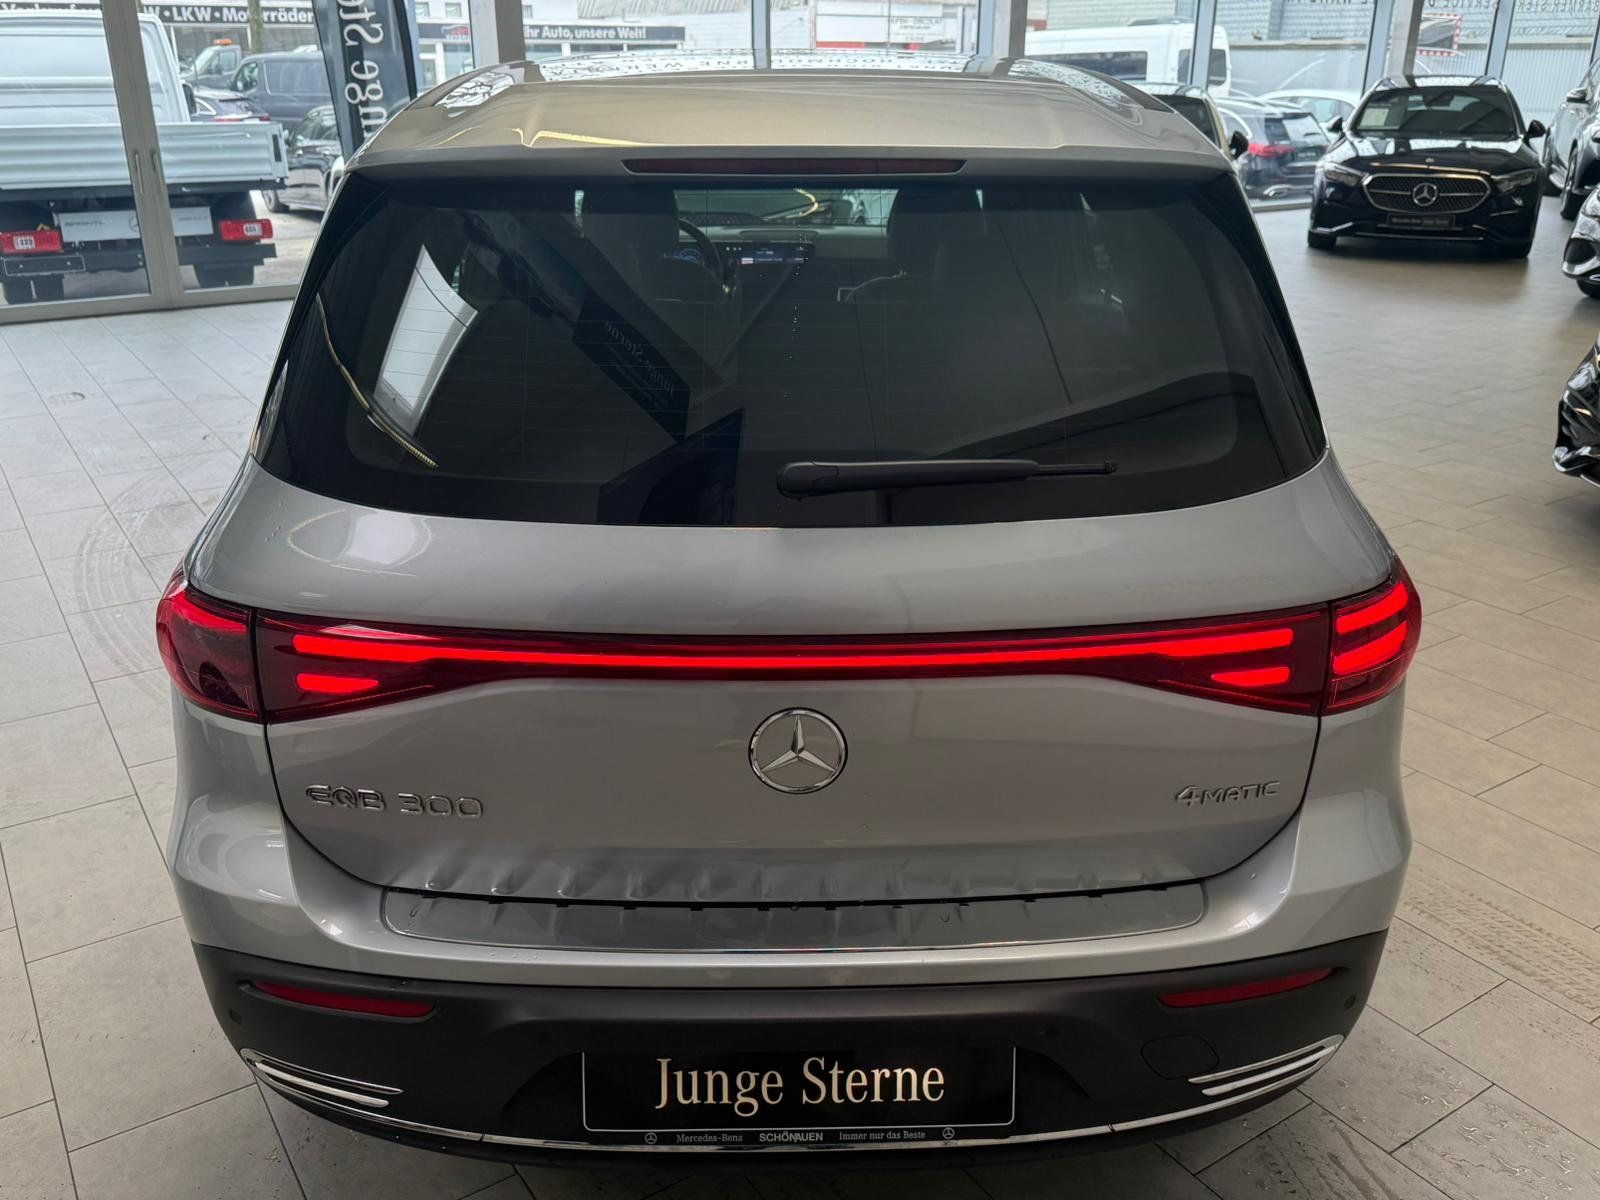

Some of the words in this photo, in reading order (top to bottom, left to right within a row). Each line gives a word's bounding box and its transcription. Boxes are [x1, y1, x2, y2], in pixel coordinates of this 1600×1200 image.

[172, 7, 212, 22] LKW
[223, 7, 314, 23] Morräder
[542, 26, 573, 40] Auto,
[574, 29, 615, 39] unsere
[305, 784, 386, 812] EQB
[398, 792, 484, 818] 300
[1174, 780, 1280, 808] 4MATIC
[654, 1057, 784, 1118] Junge
[802, 1056, 946, 1105] Sterne
[676, 1133, 743, 1144] Mercedes-Benz
[759, 1131, 824, 1143] SCHÖNAUEN
[839, 1131, 868, 1141] Immer
[886, 1131, 901, 1140] das
[903, 1130, 926, 1140] Beste
